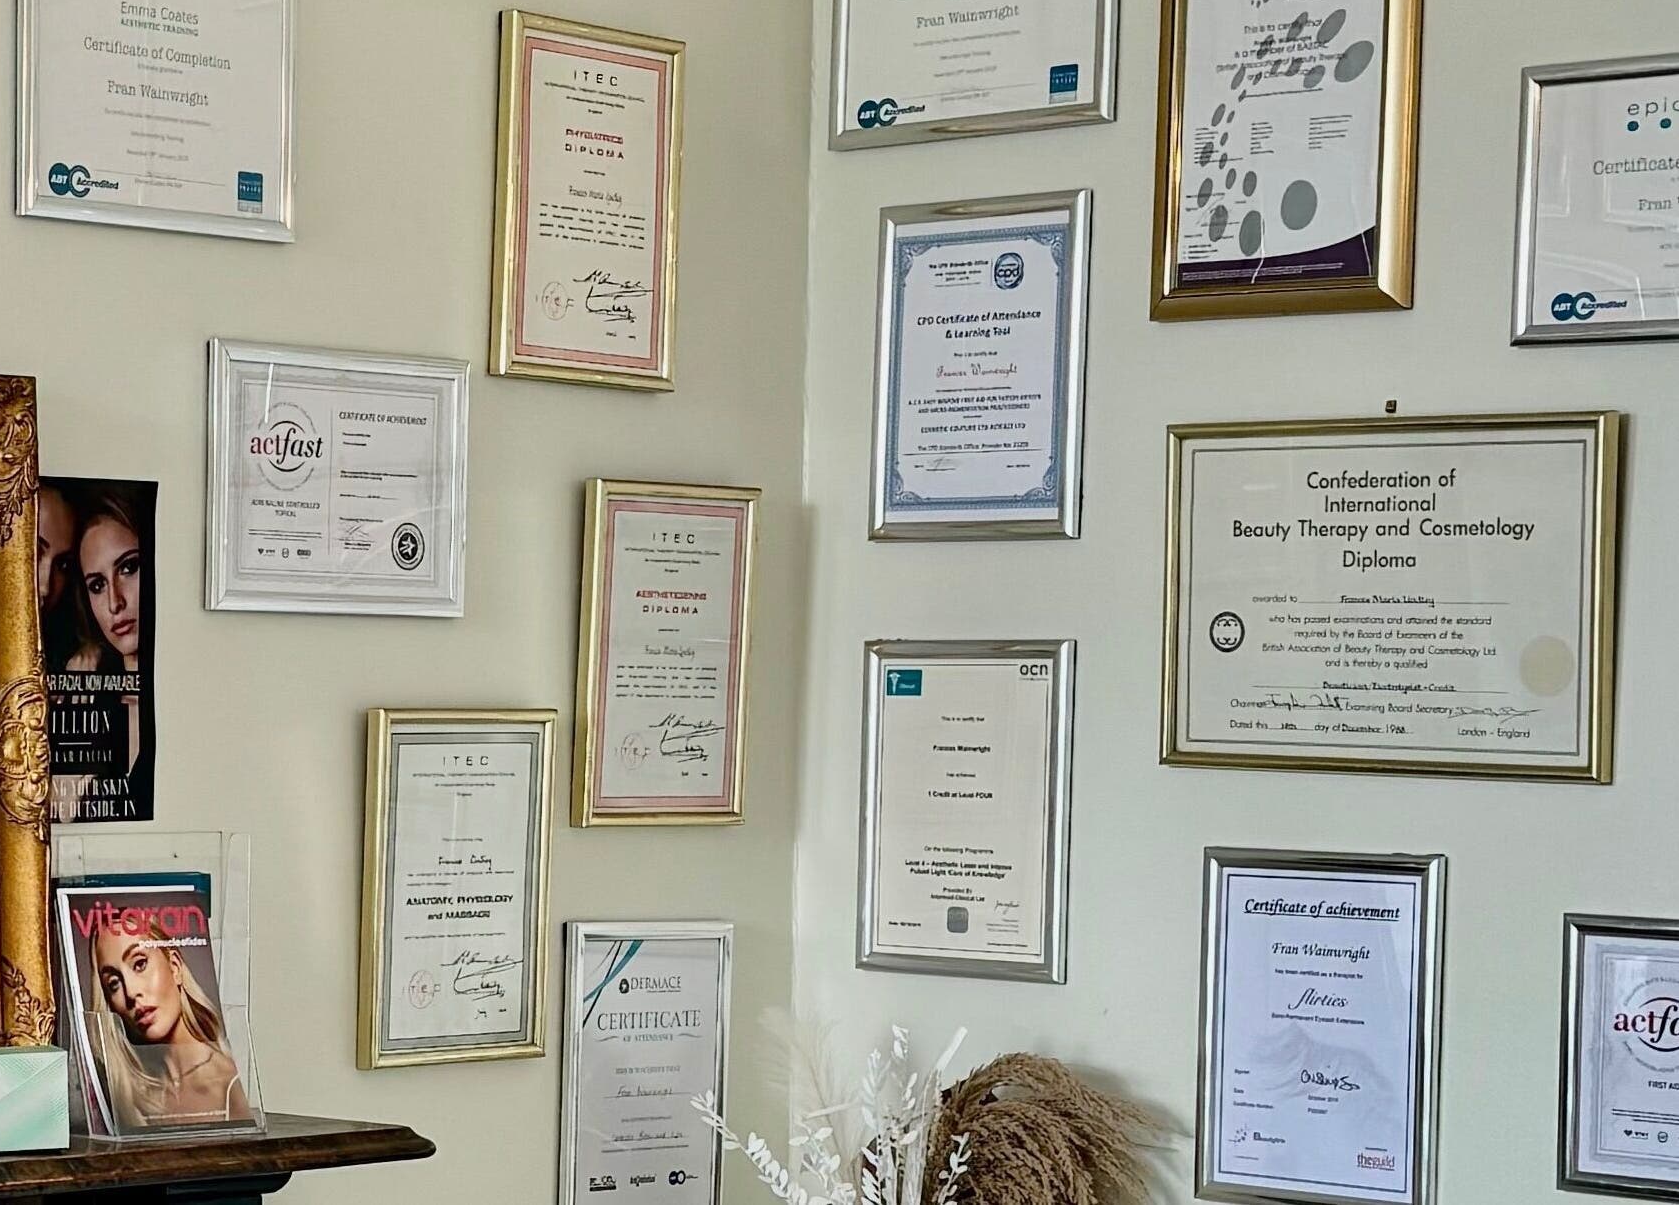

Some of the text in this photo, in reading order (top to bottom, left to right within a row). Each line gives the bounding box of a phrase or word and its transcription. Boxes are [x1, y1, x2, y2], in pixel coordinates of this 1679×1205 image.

[121, 2, 199, 25] Emma Coates
[917, 5, 1019, 29] Fran Wainwright
[84, 37, 231, 70] Certificate of Completion
[108, 80, 209, 106] Fran Wainwright
[77, 177, 119, 190] Accredited
[1639, 199, 1671, 211] Fran
[1581, 300, 1627, 309] Accredited
[936, 315, 979, 324] Certificate
[992, 310, 1041, 320] Attendance
[955, 327, 1010, 338] Learning Tool
[250, 427, 323, 465] actfast
[1307, 468, 1457, 490] Confederation of
[1324, 495, 1436, 513] International
[1233, 518, 1534, 541] Beauty Therapy and Cosmetology
[1342, 549, 1416, 572] Diploma
[643, 605, 698, 614] DIPLOMA
[1345, 645, 1371, 654] Beauty
[1375, 645, 1407, 656] Therapy
[58, 674, 140, 691] FACIAL NOW AVAILABLE
[1497, 728, 1530, 738] England
[75, 779, 129, 795] YOUR SKIN
[125, 800, 136, 816] IN
[1244, 898, 1400, 918] Certificate of achievement
[73, 900, 205, 937] vitaran
[1272, 943, 1370, 961] Fran Wainwright
[631, 976, 681, 990] DERMACE
[1289, 988, 1347, 1010] flirties
[598, 1010, 700, 1031] CERTIFICATE
[1648, 1081, 1667, 1090] FIRST
